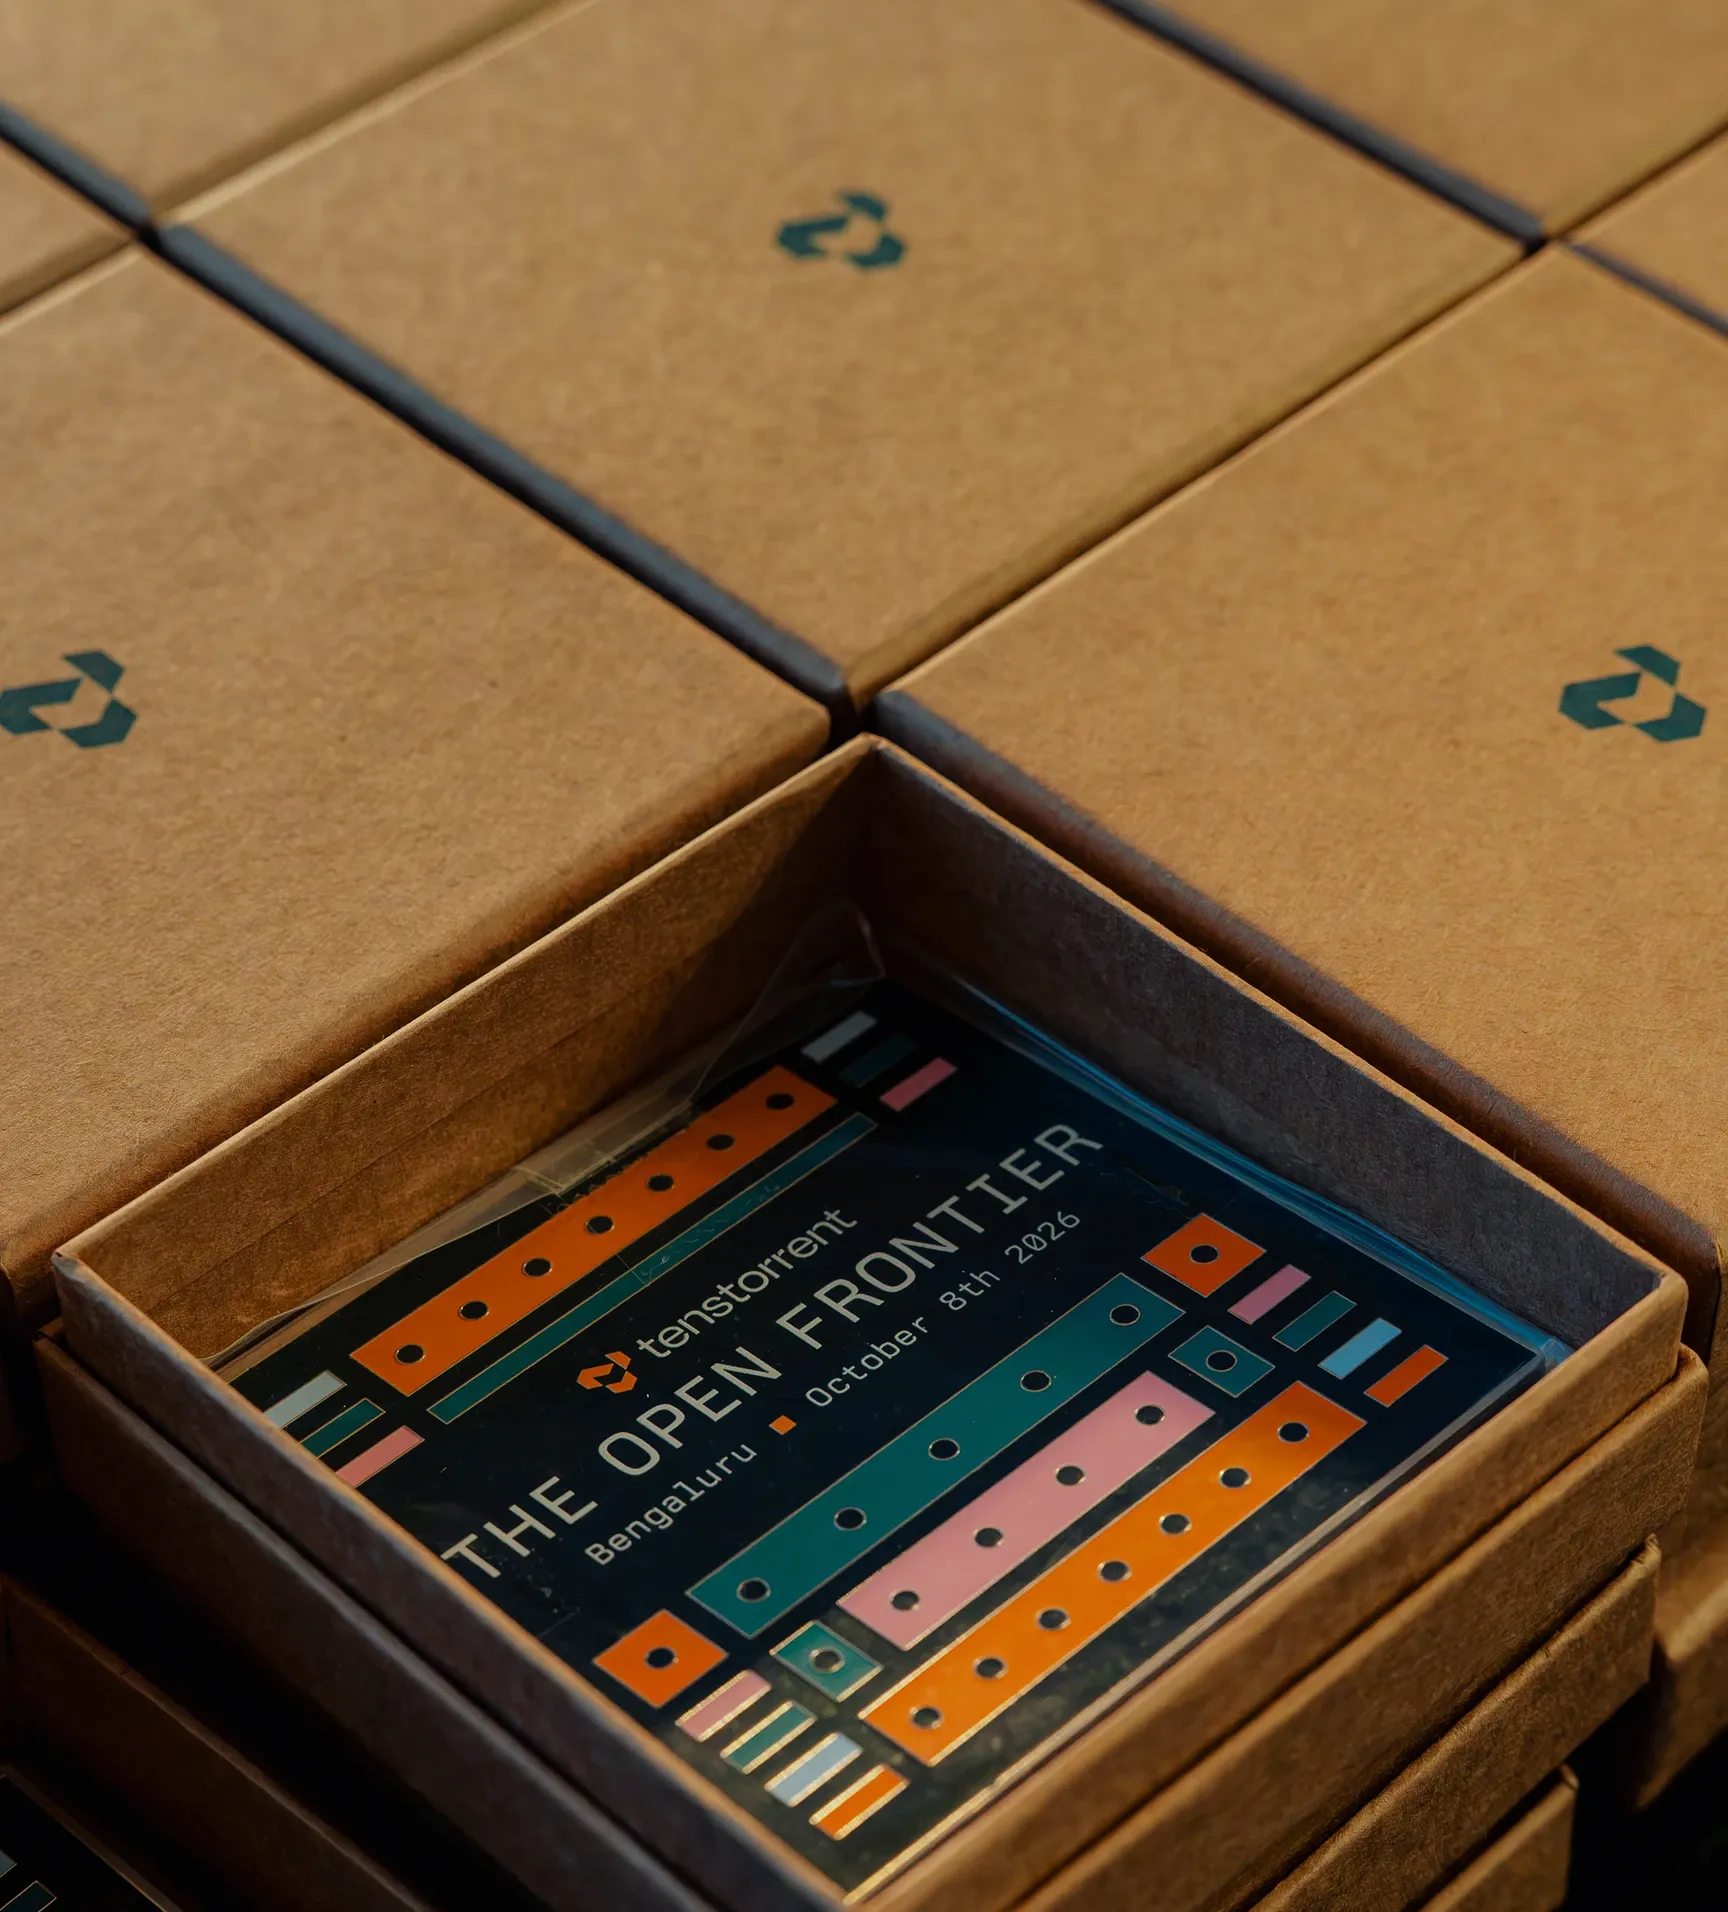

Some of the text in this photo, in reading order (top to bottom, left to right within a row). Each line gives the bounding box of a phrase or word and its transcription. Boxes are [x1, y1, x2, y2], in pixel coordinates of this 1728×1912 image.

[440, 1125, 1102, 1578] THE OPEN FRONTIER
[584, 1211, 1081, 1566] Bengaluru October 8th 2026
[636, 1209, 858, 1358] tenstorrent
